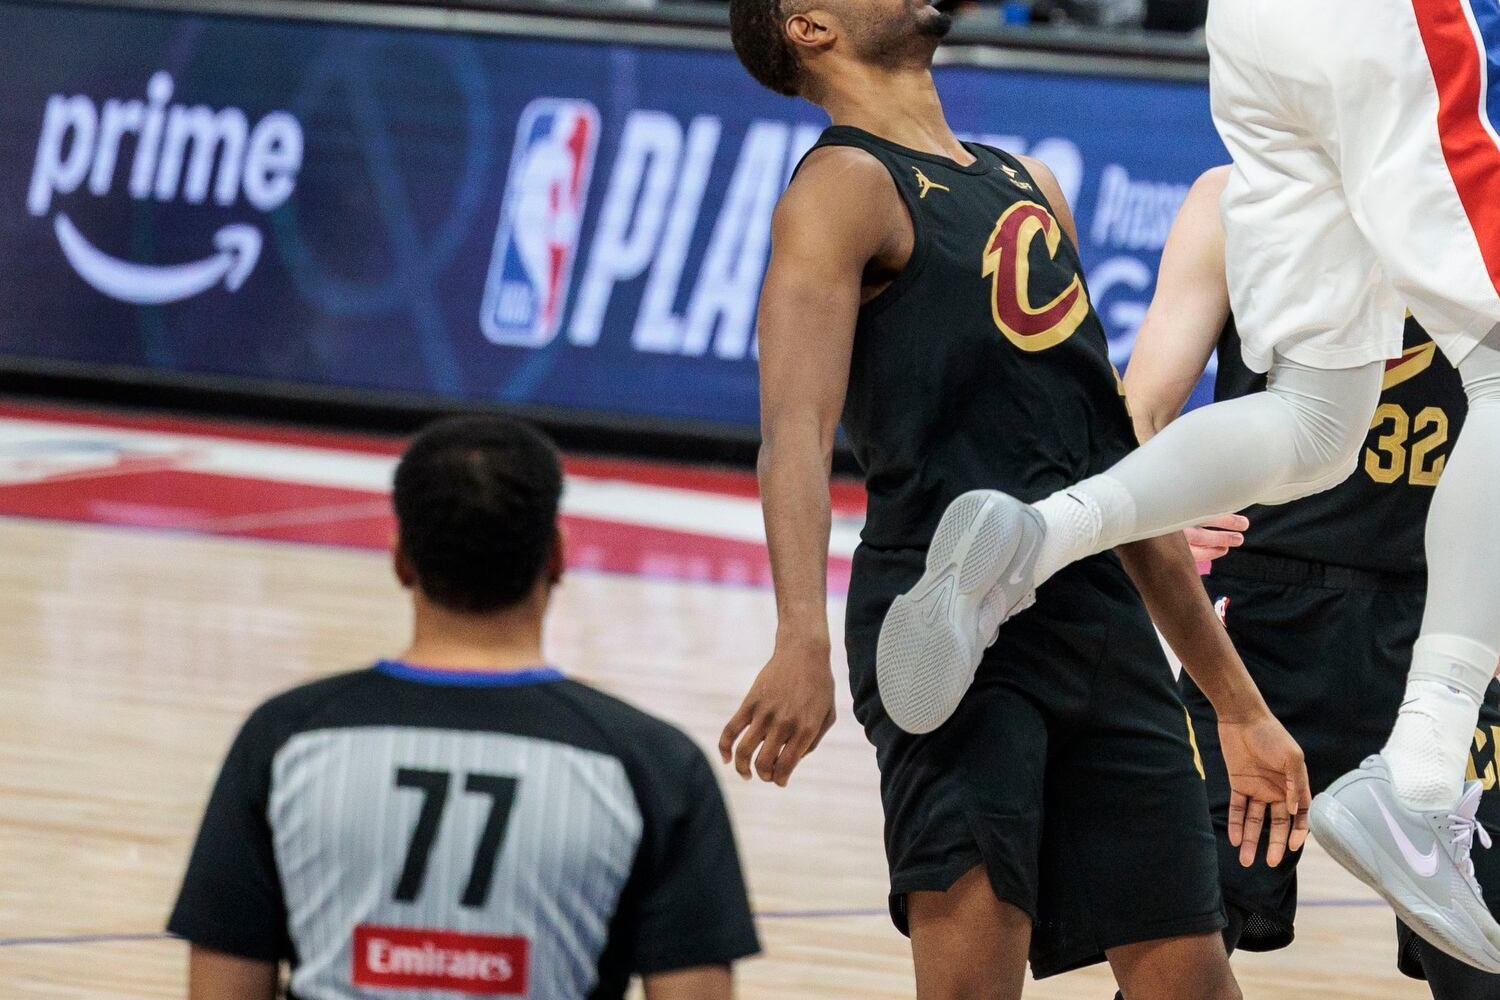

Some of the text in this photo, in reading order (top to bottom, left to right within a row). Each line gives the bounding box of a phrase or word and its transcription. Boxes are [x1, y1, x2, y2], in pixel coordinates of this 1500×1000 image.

[28, 71, 304, 216] prime
[1365, 403, 1448, 486] 32
[394, 767, 519, 908] 77
[366, 938, 513, 982] Emirates
